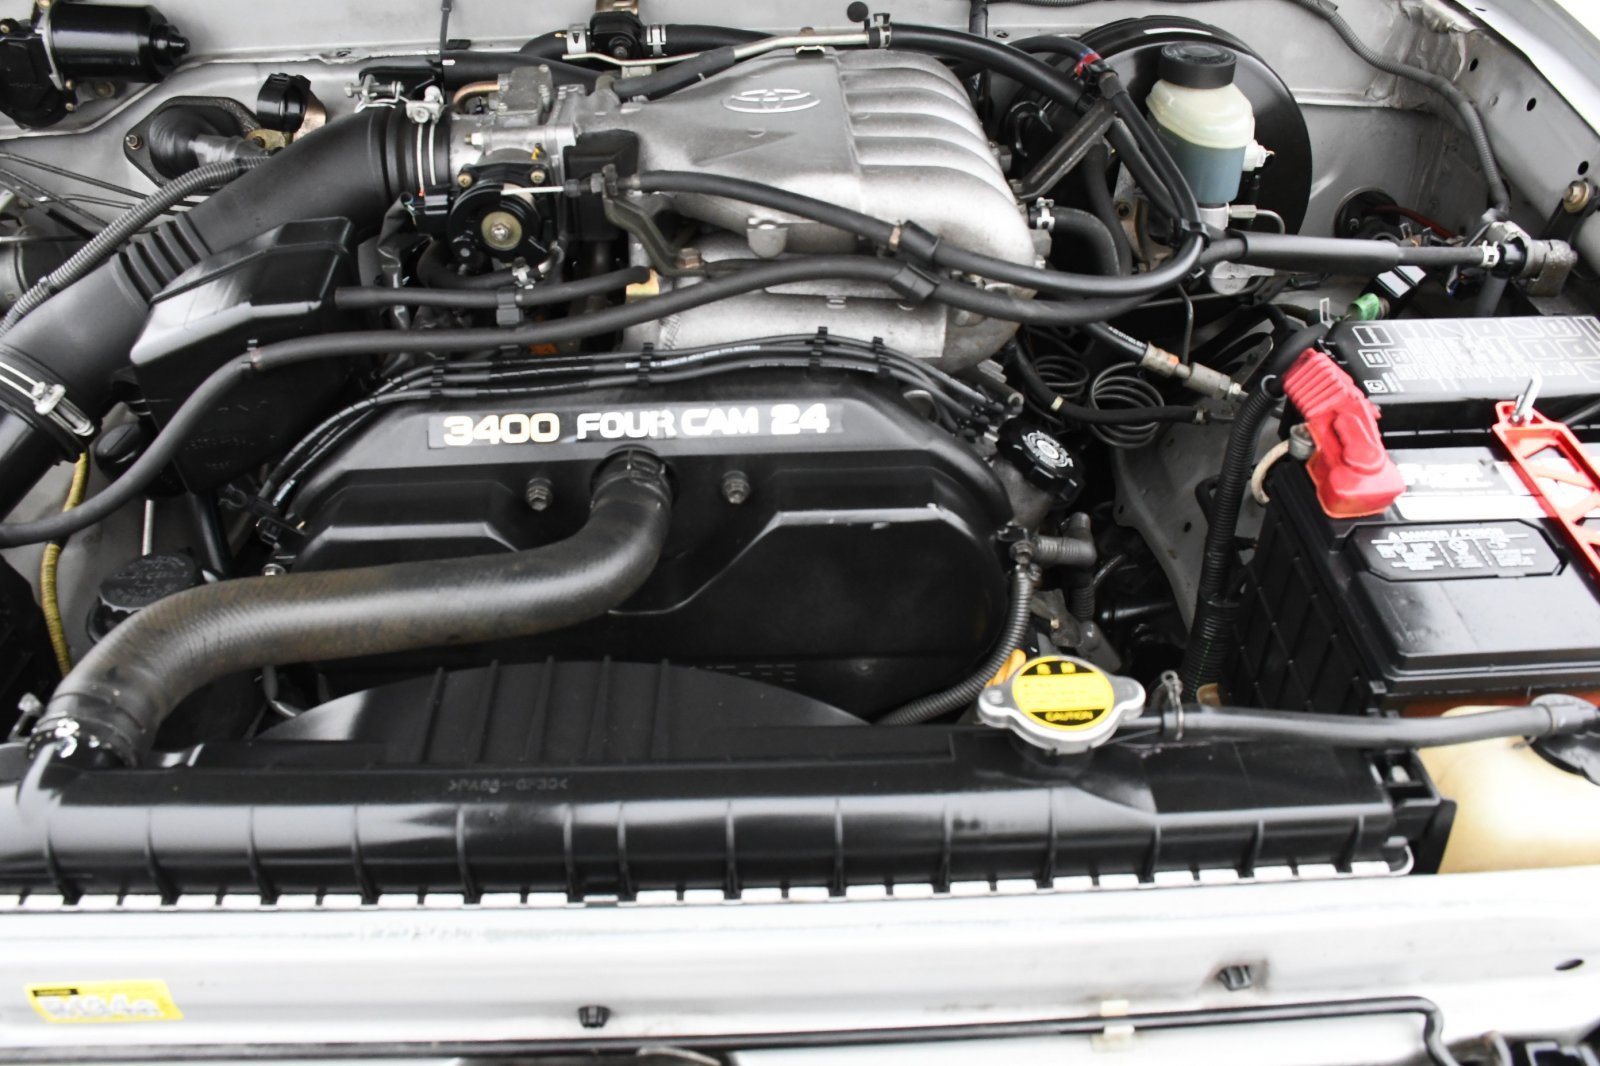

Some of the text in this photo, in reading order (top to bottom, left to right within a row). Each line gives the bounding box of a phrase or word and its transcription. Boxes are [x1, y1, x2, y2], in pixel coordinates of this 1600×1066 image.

[443, 403, 830, 446] 3400 FOUR CAM 24
